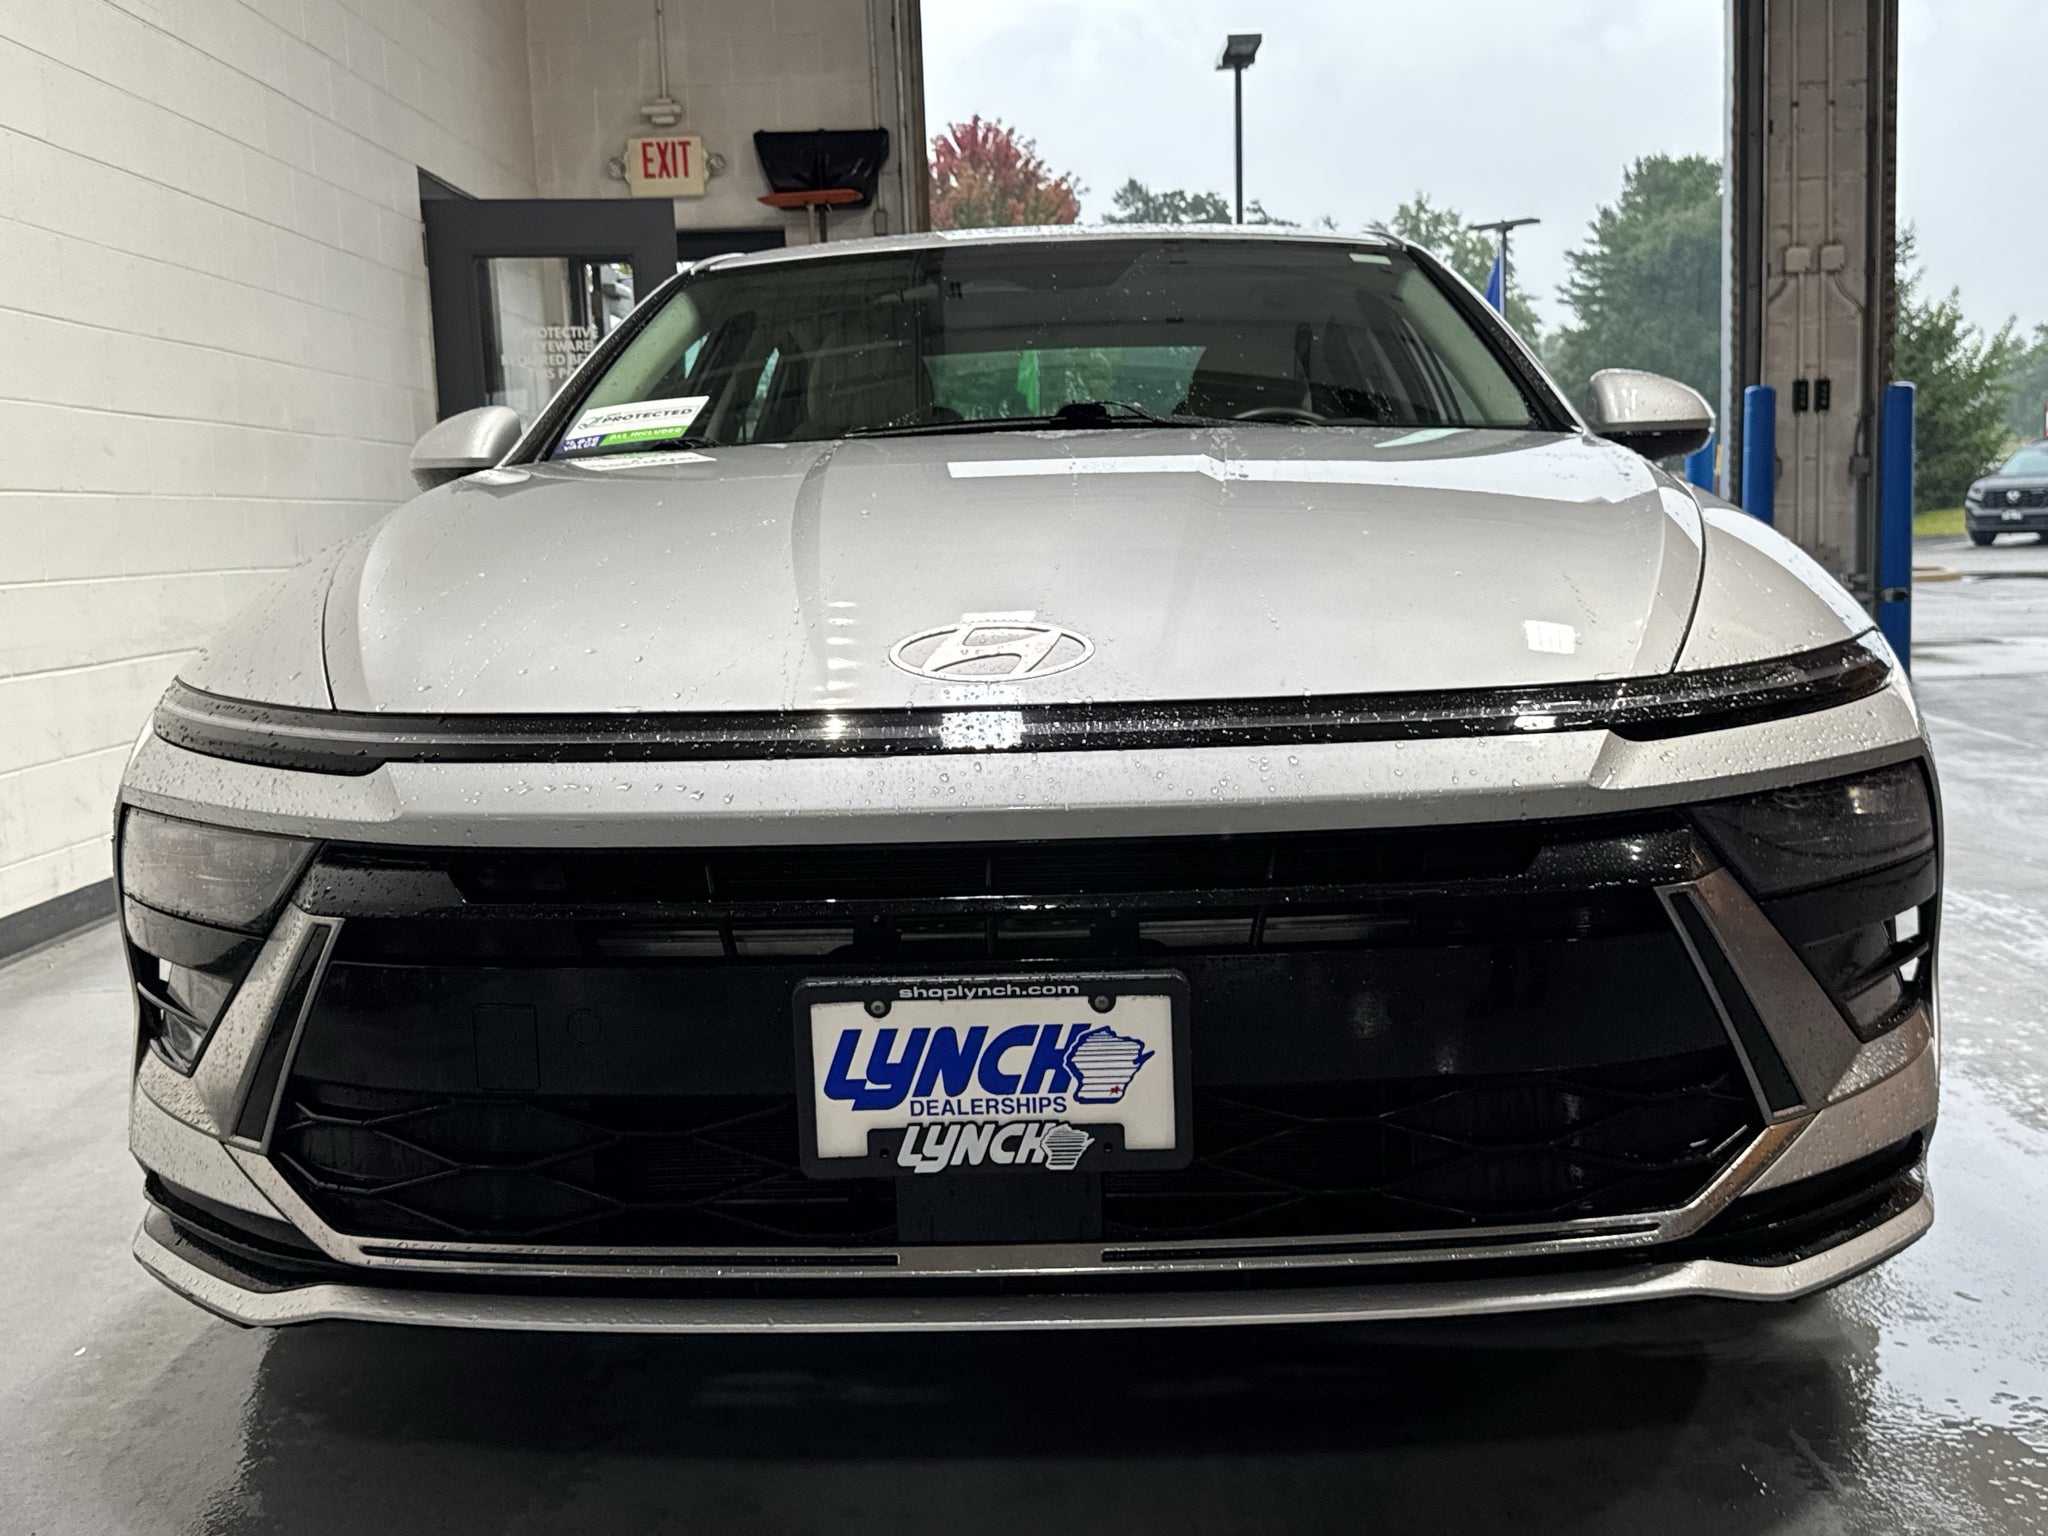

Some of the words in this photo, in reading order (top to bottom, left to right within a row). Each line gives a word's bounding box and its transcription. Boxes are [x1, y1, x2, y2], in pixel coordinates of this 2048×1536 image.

[641, 141, 691, 178] EXIT
[602, 408, 693, 424] PROTECTED
[899, 984, 1079, 1000] shoplynch.com
[824, 1023, 1092, 1111] LYNCH
[910, 1096, 1067, 1117] DEALERSHIPS
[897, 1121, 1060, 1173] LYNCH
